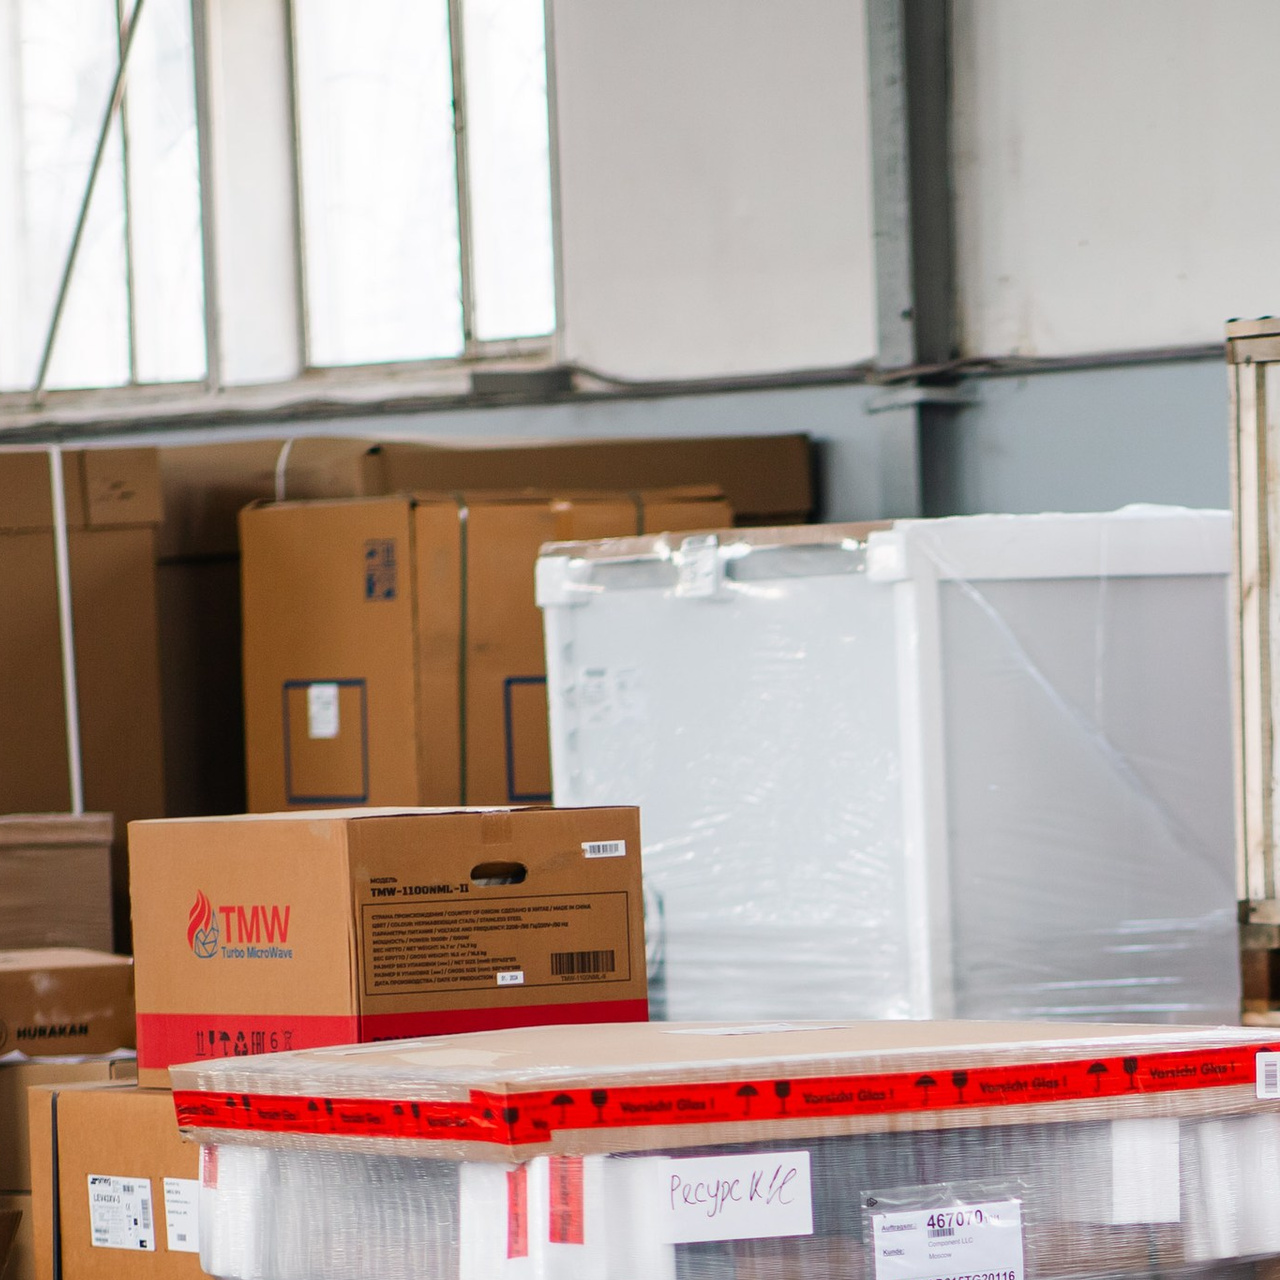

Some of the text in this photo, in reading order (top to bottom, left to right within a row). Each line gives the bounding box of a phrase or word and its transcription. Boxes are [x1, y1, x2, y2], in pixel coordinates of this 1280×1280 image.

[219, 905, 290, 943] TMW
[221, 946, 293, 959] Turbo MicroWave
[16, 1023, 89, 1039] HURAKAN
[671, 1174, 742, 1218] Ресурс
[926, 1209, 983, 1229] 467070
[928, 1237, 974, 1249] Component LLC
[928, 1252, 952, 1260] Moscow
